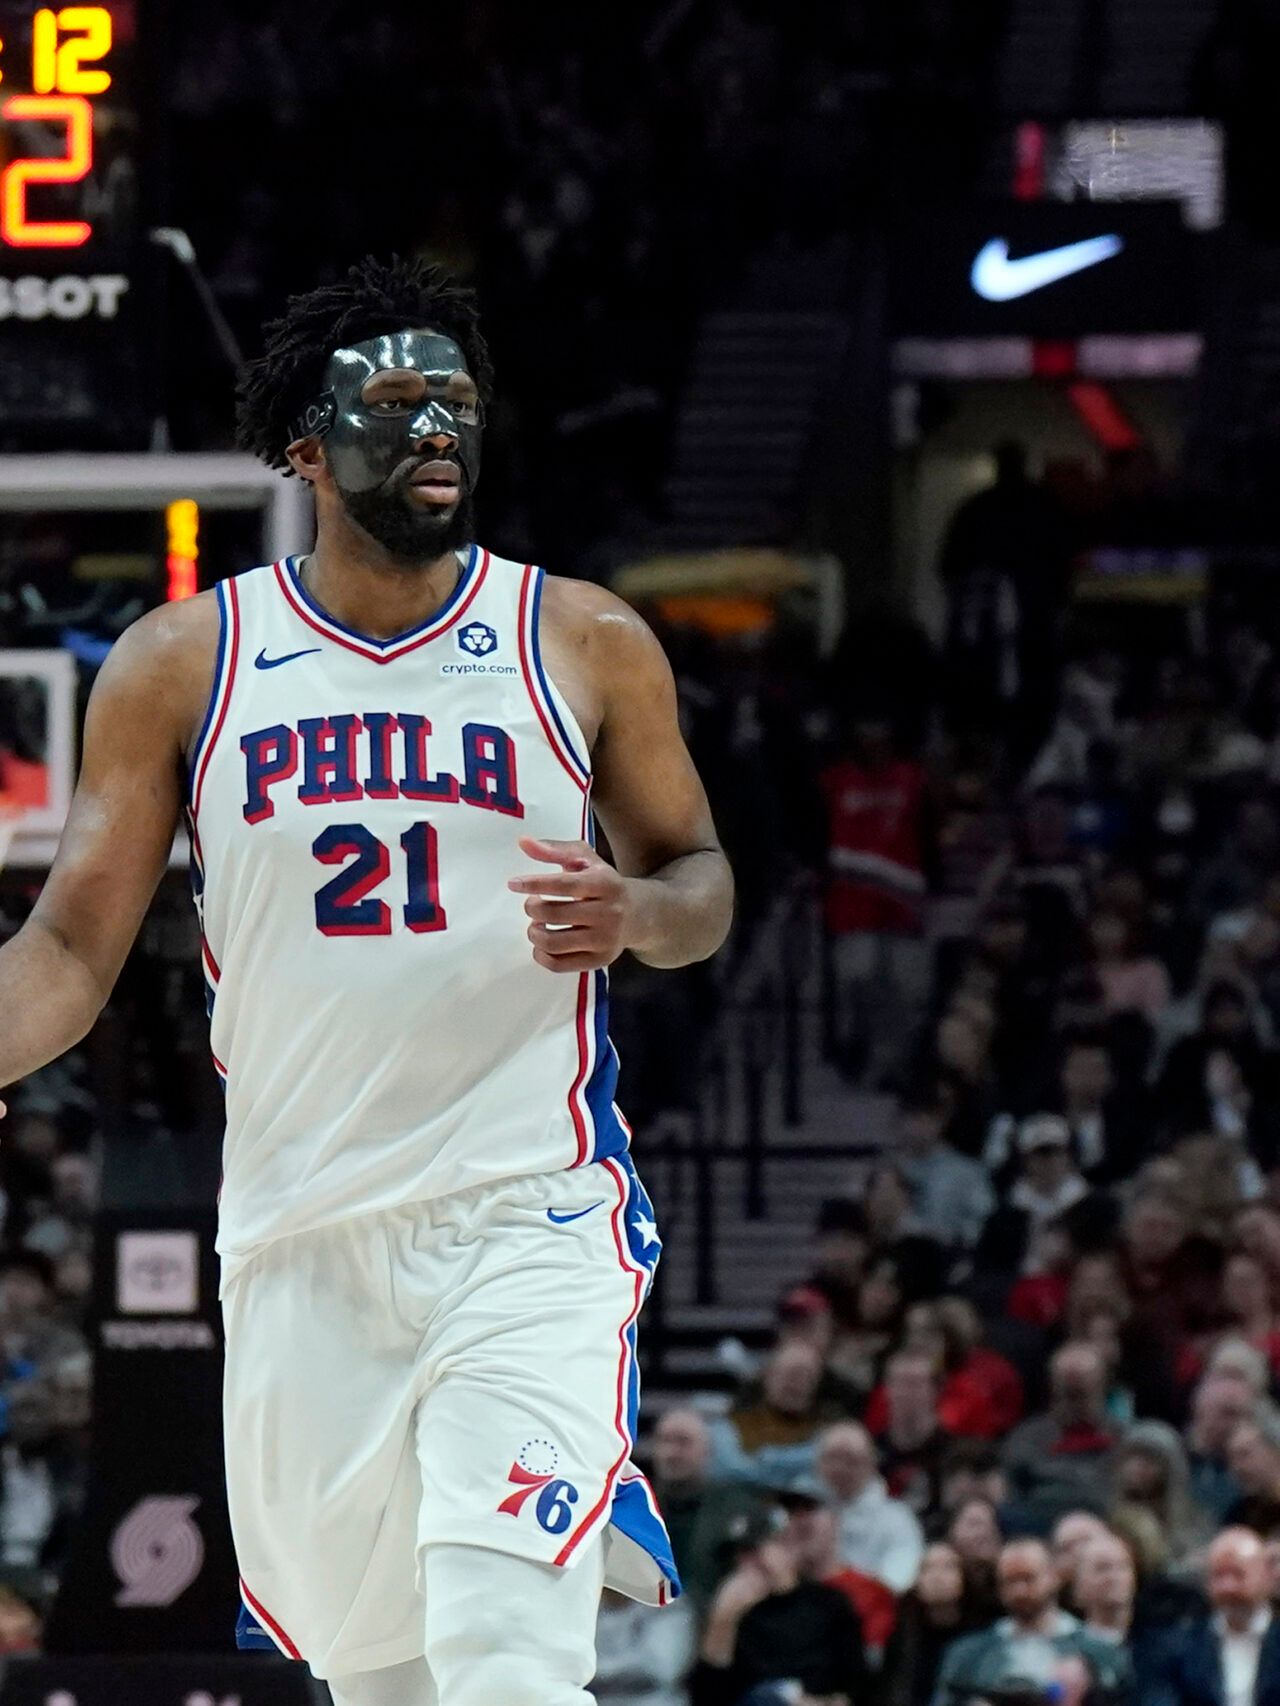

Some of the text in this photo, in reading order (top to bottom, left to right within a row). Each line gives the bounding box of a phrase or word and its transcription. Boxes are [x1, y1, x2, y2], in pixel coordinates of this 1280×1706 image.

[442, 663, 517, 675] crypto.com
[240, 712, 524, 826] PHILA
[312, 821, 447, 937] 21
[497, 1460, 579, 1534] 76
